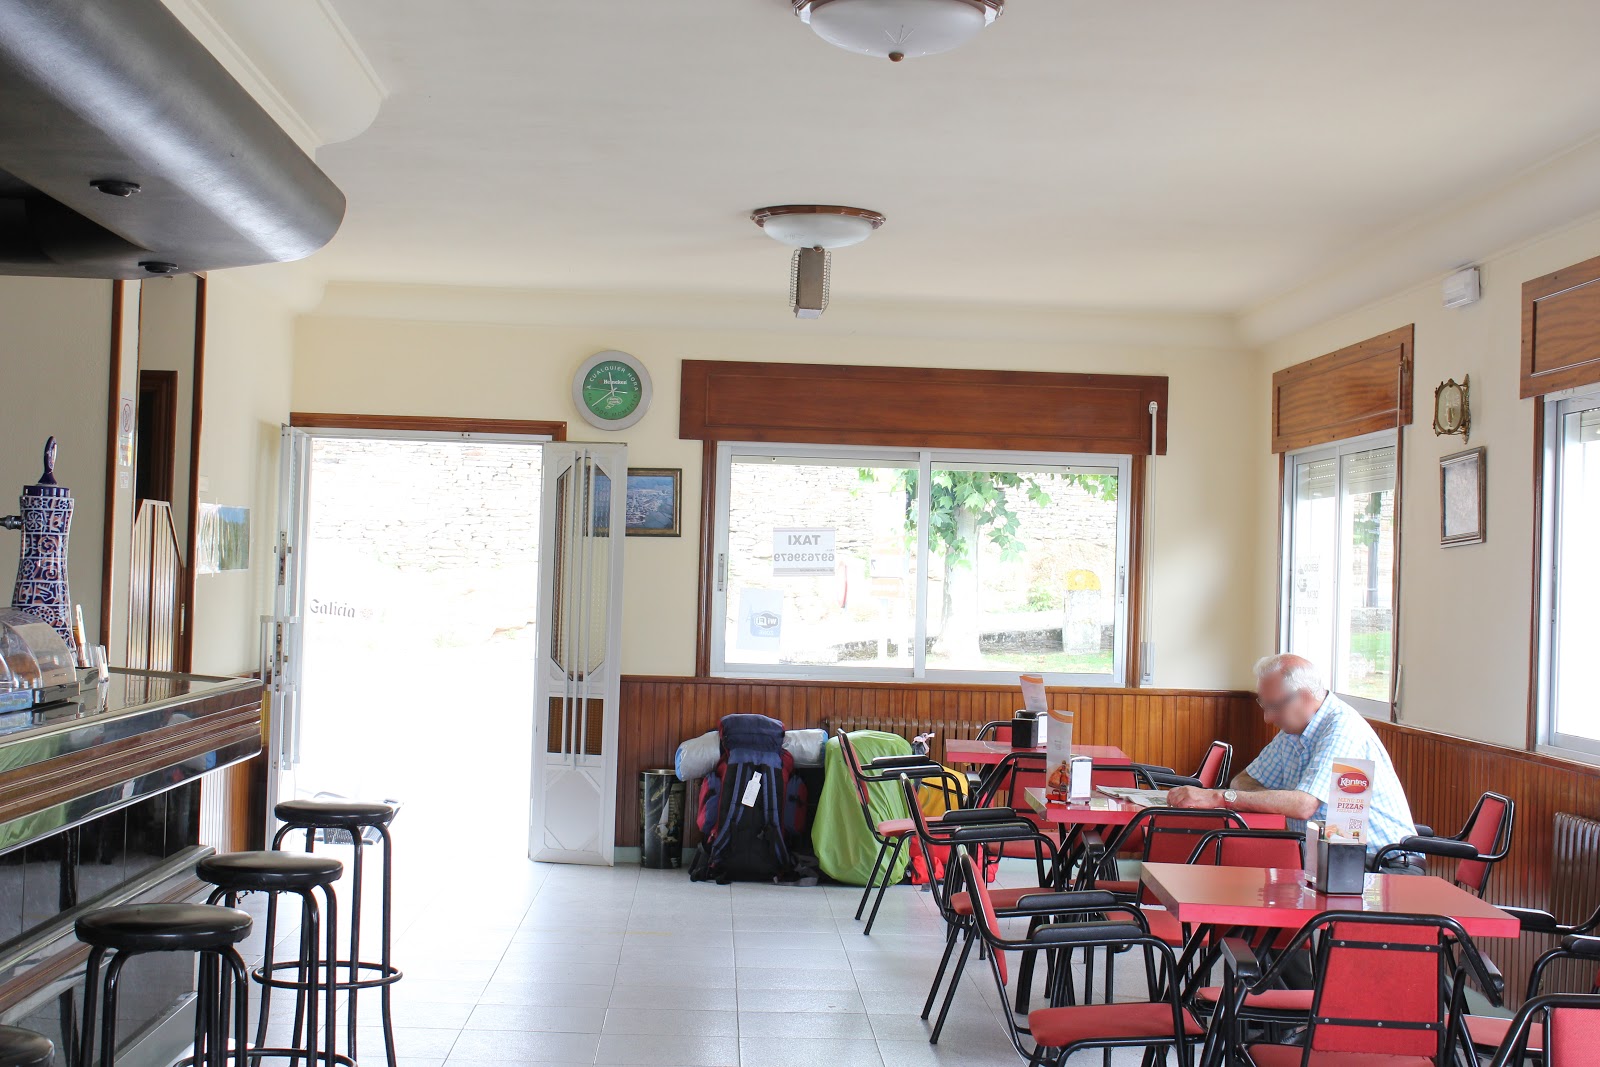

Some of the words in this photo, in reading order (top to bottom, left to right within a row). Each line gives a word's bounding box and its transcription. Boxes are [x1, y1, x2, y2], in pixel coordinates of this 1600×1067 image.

[589, 365, 626, 382] CUALQUIER
[627, 372, 639, 391] HORA
[309, 598, 356, 618] Galicia
